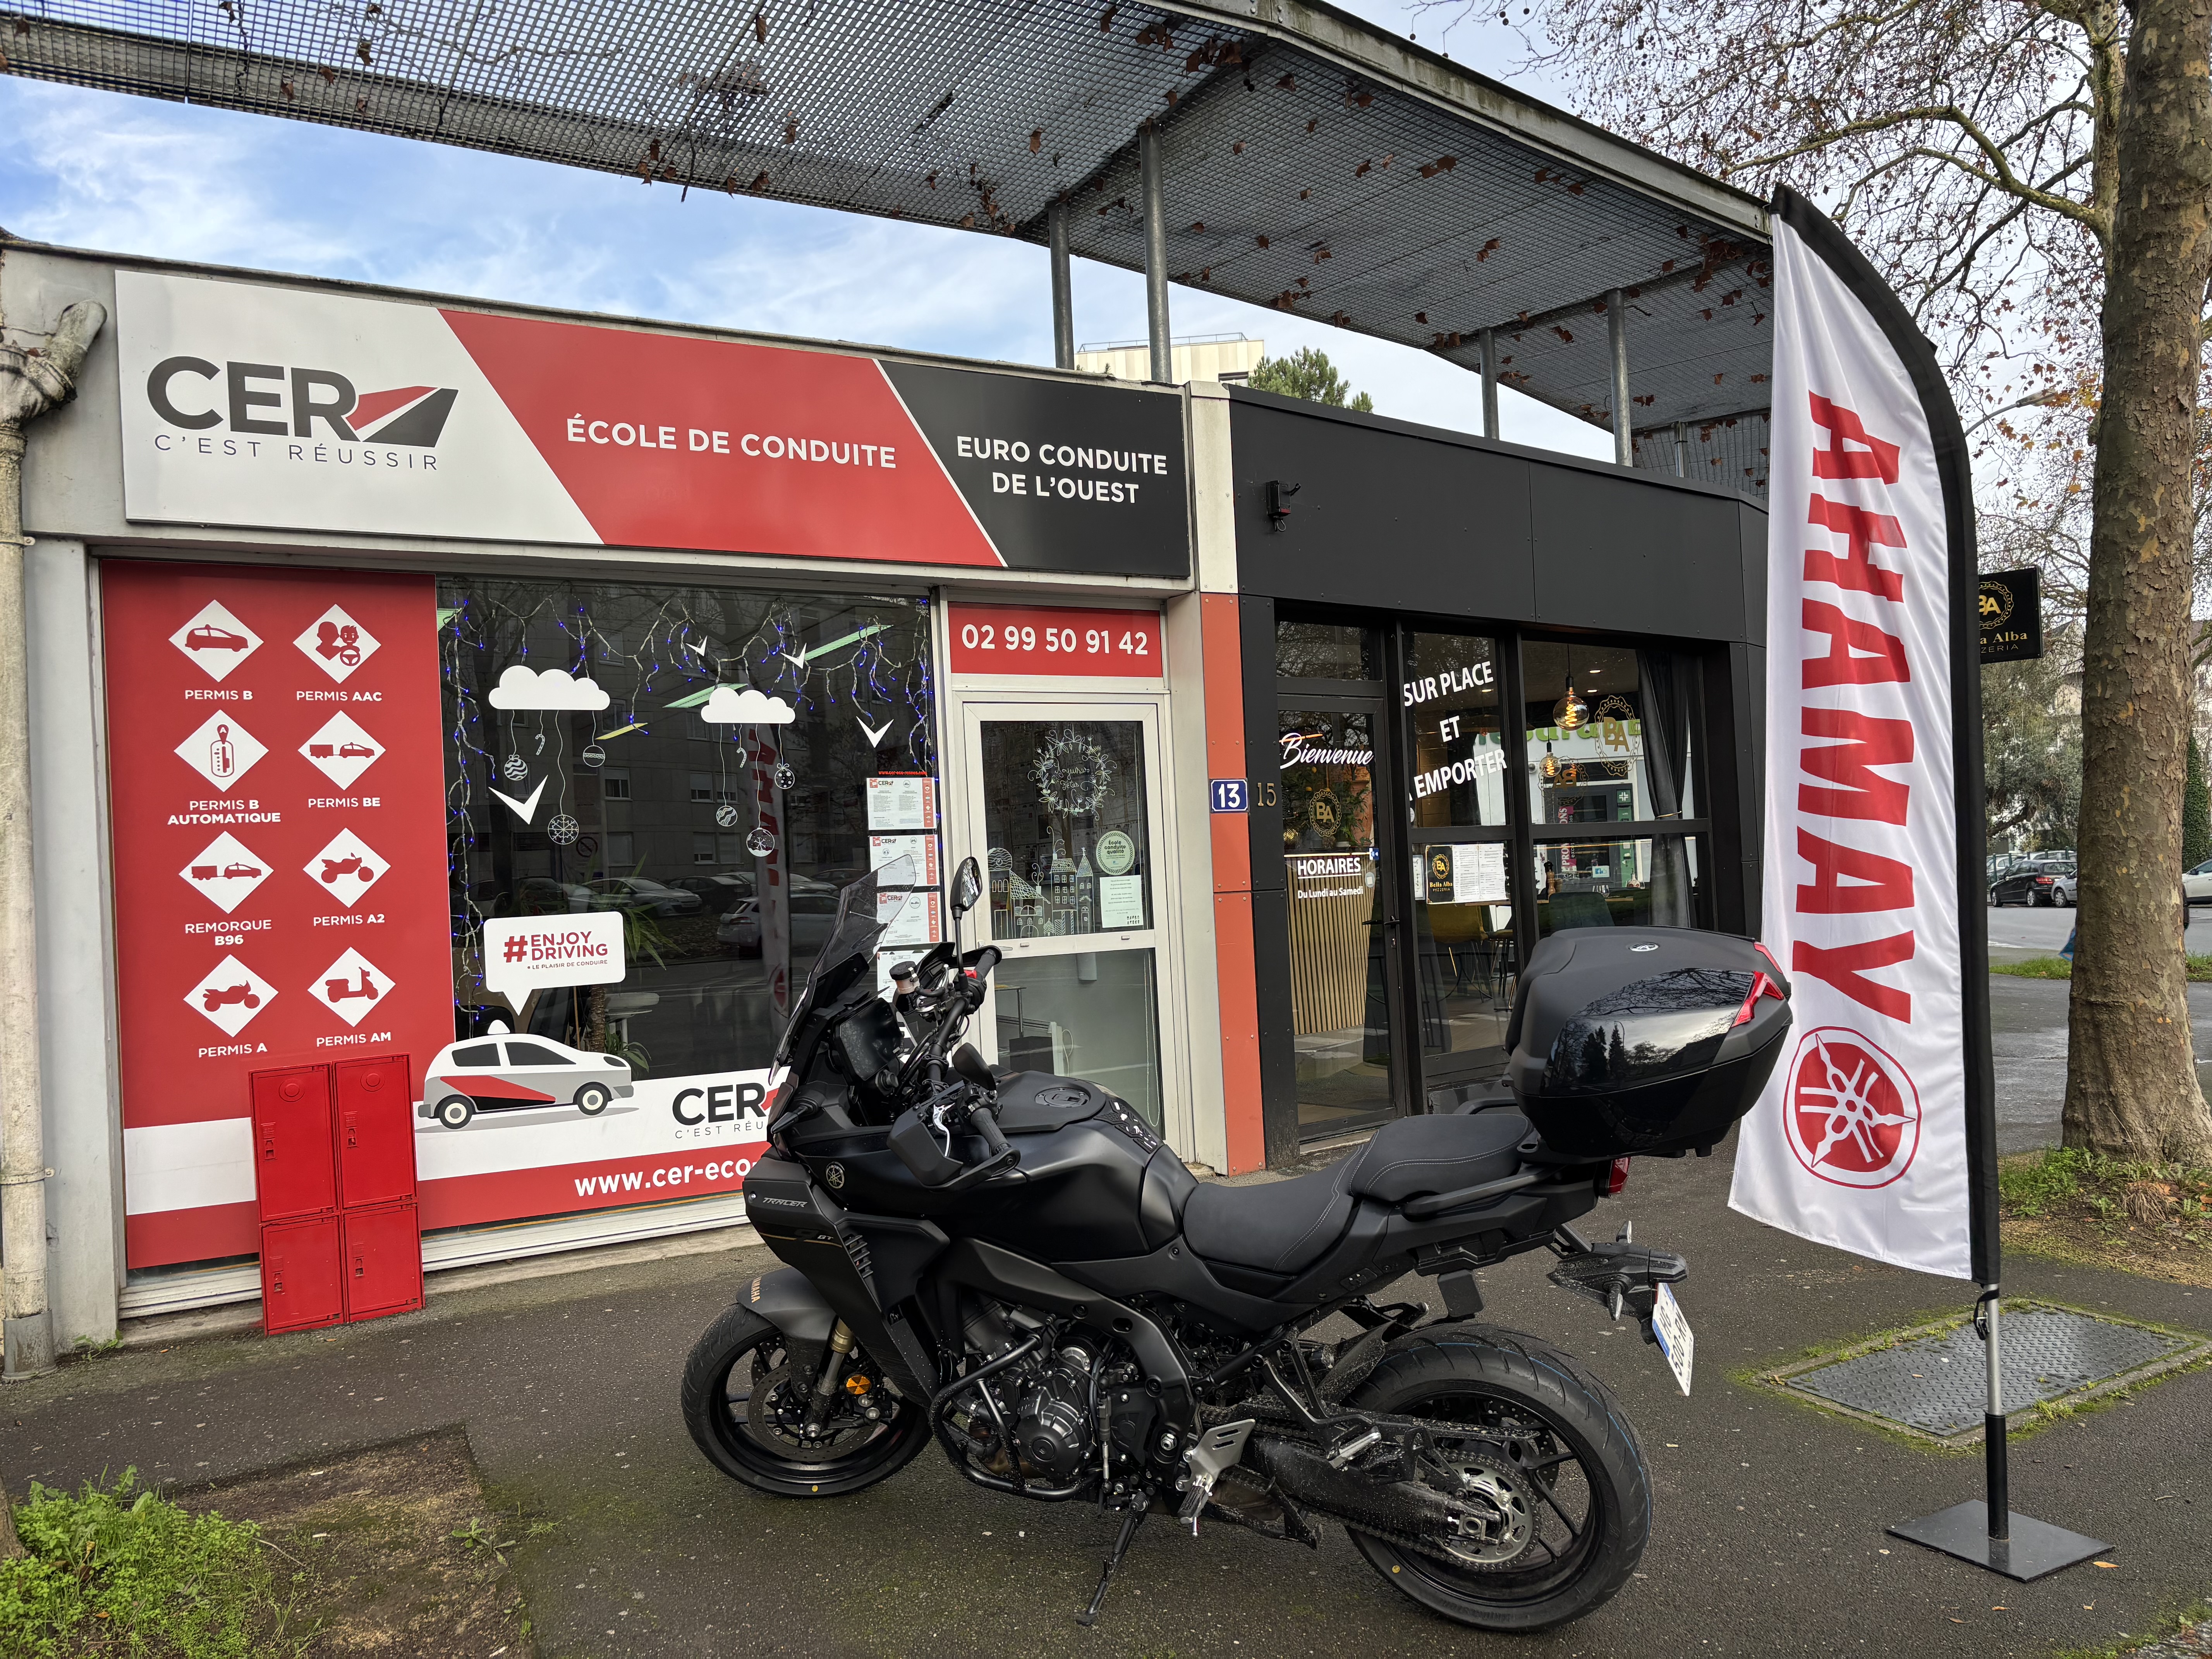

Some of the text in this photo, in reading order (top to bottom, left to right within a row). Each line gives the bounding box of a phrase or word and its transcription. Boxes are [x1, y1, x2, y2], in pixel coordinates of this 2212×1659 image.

[147, 356, 361, 441] CER
[567, 413, 896, 468] ÉCOLE DE CONDUITE
[154, 434, 438, 471] C'EST RÉUSSIR
[957, 436, 1167, 475] EURO CONDUITE
[993, 472, 1139, 503] DE L'OUEST
[962, 624, 1148, 655] 02 99 50 91 42
[1993, 632, 2028, 643] Alba
[1981, 644, 2018, 653] ZERIA
[1404, 661, 1494, 707] SUR PLACE
[185, 690, 253, 700] PERMIS B
[297, 691, 382, 701] PERMIS AAC
[1439, 716, 1460, 742] ET
[1604, 717, 1630, 752] BA
[1280, 733, 1374, 769] Bienvenue
[1414, 749, 1507, 799] EMPORTER
[308, 797, 381, 808] PERMIS BE
[1219, 783, 1240, 808] 13
[1257, 783, 1276, 807] 15
[189, 800, 259, 811] PERMIS B
[1316, 802, 1334, 823] BA
[167, 812, 281, 825] AUTOMATIQUE
[1298, 858, 1361, 875] HORAIRES
[1436, 860, 1446, 871] BA
[1298, 890, 1308, 899] Du
[1309, 888, 1328, 898] Lundi
[1339, 886, 1363, 895] Samedi
[185, 920, 272, 934] REMORQUE
[313, 914, 385, 926] PERMIS A2
[215, 934, 244, 945] B96
[532, 943, 608, 961] DRIVING
[316, 1032, 392, 1047] PERMIS AM
[198, 1043, 268, 1058] PERMIS A
[672, 1083, 766, 1126] CER
[675, 1126, 722, 1139] C'EST
[574, 1158, 756, 1197] www.cer-eco
[763, 1197, 807, 1208] TRACER
